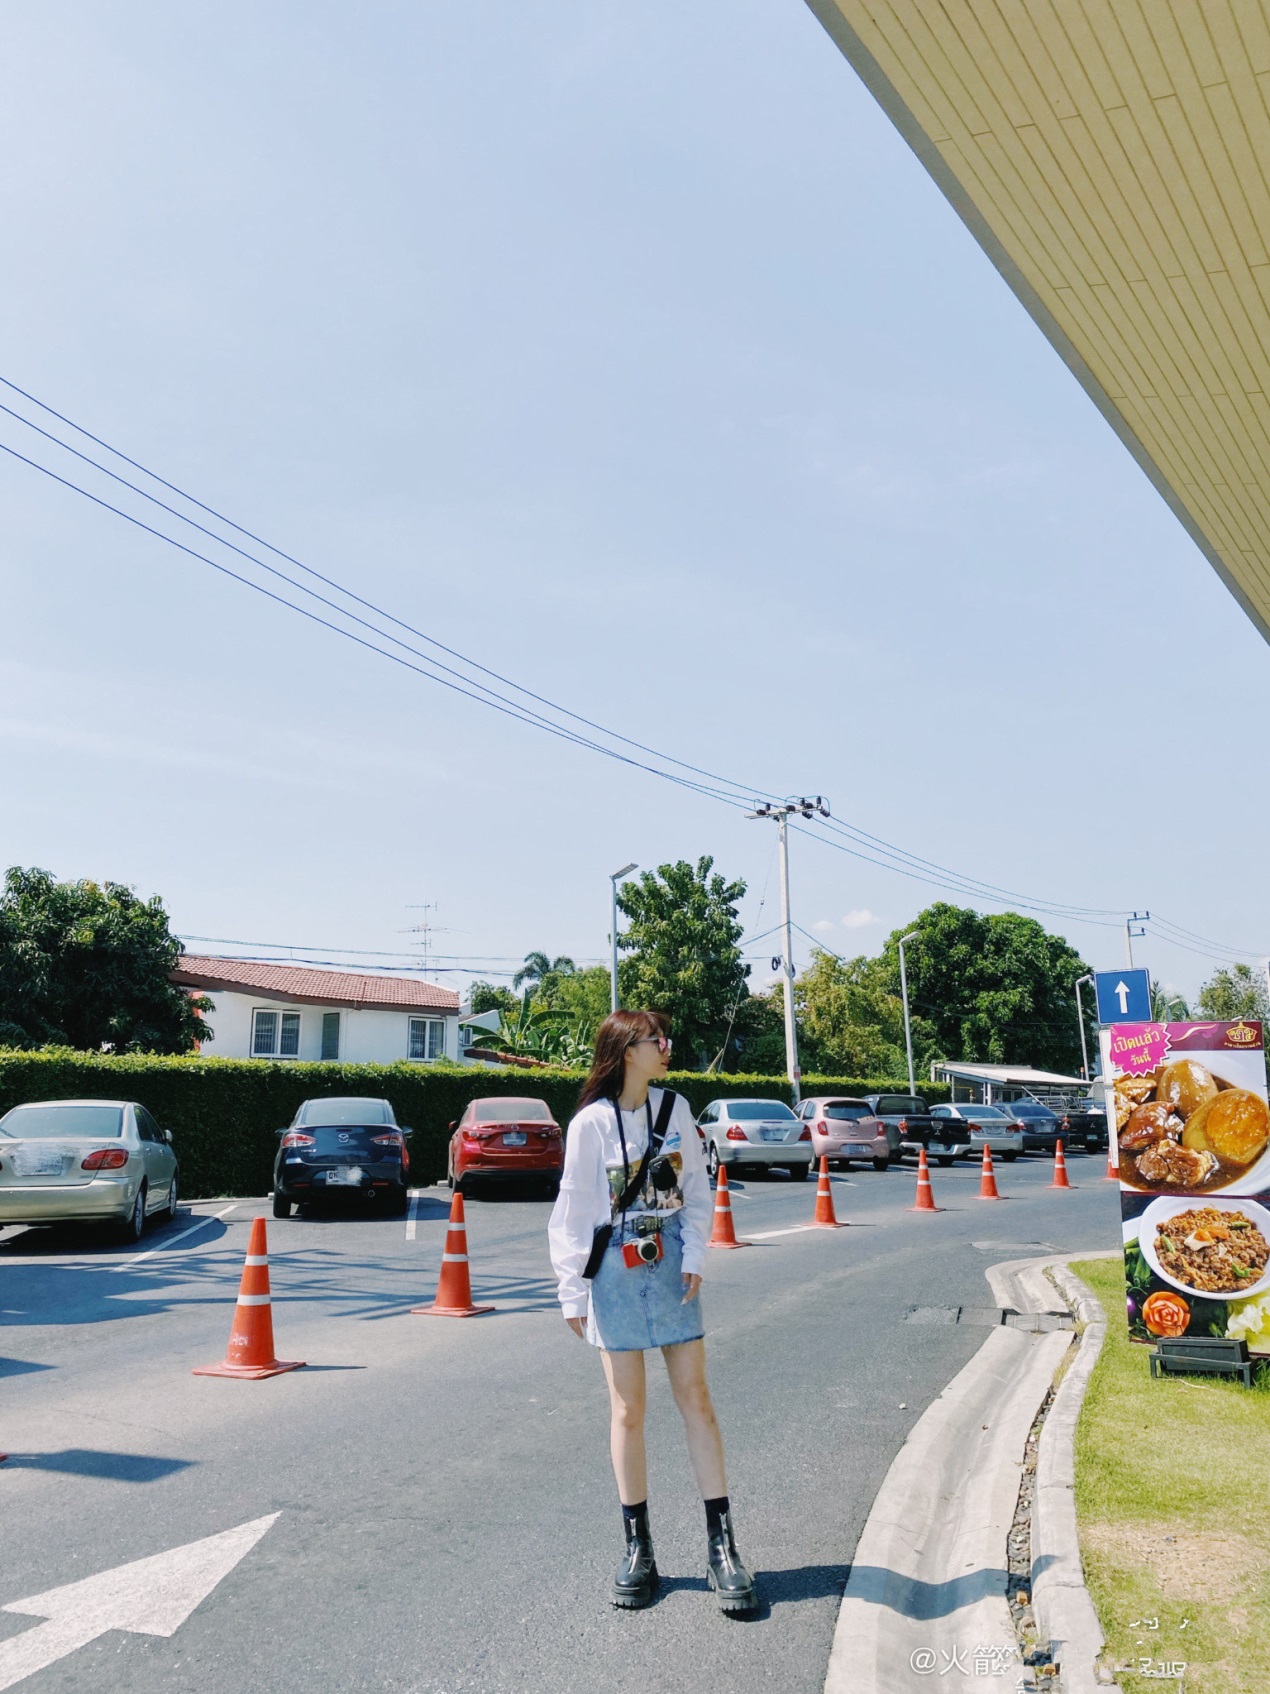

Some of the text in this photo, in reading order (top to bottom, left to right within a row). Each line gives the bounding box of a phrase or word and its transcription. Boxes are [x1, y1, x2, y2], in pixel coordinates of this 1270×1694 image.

[1113, 1027, 1160, 1053] เปิดแล้ว
[1130, 1046, 1152, 1066] วันนี้
